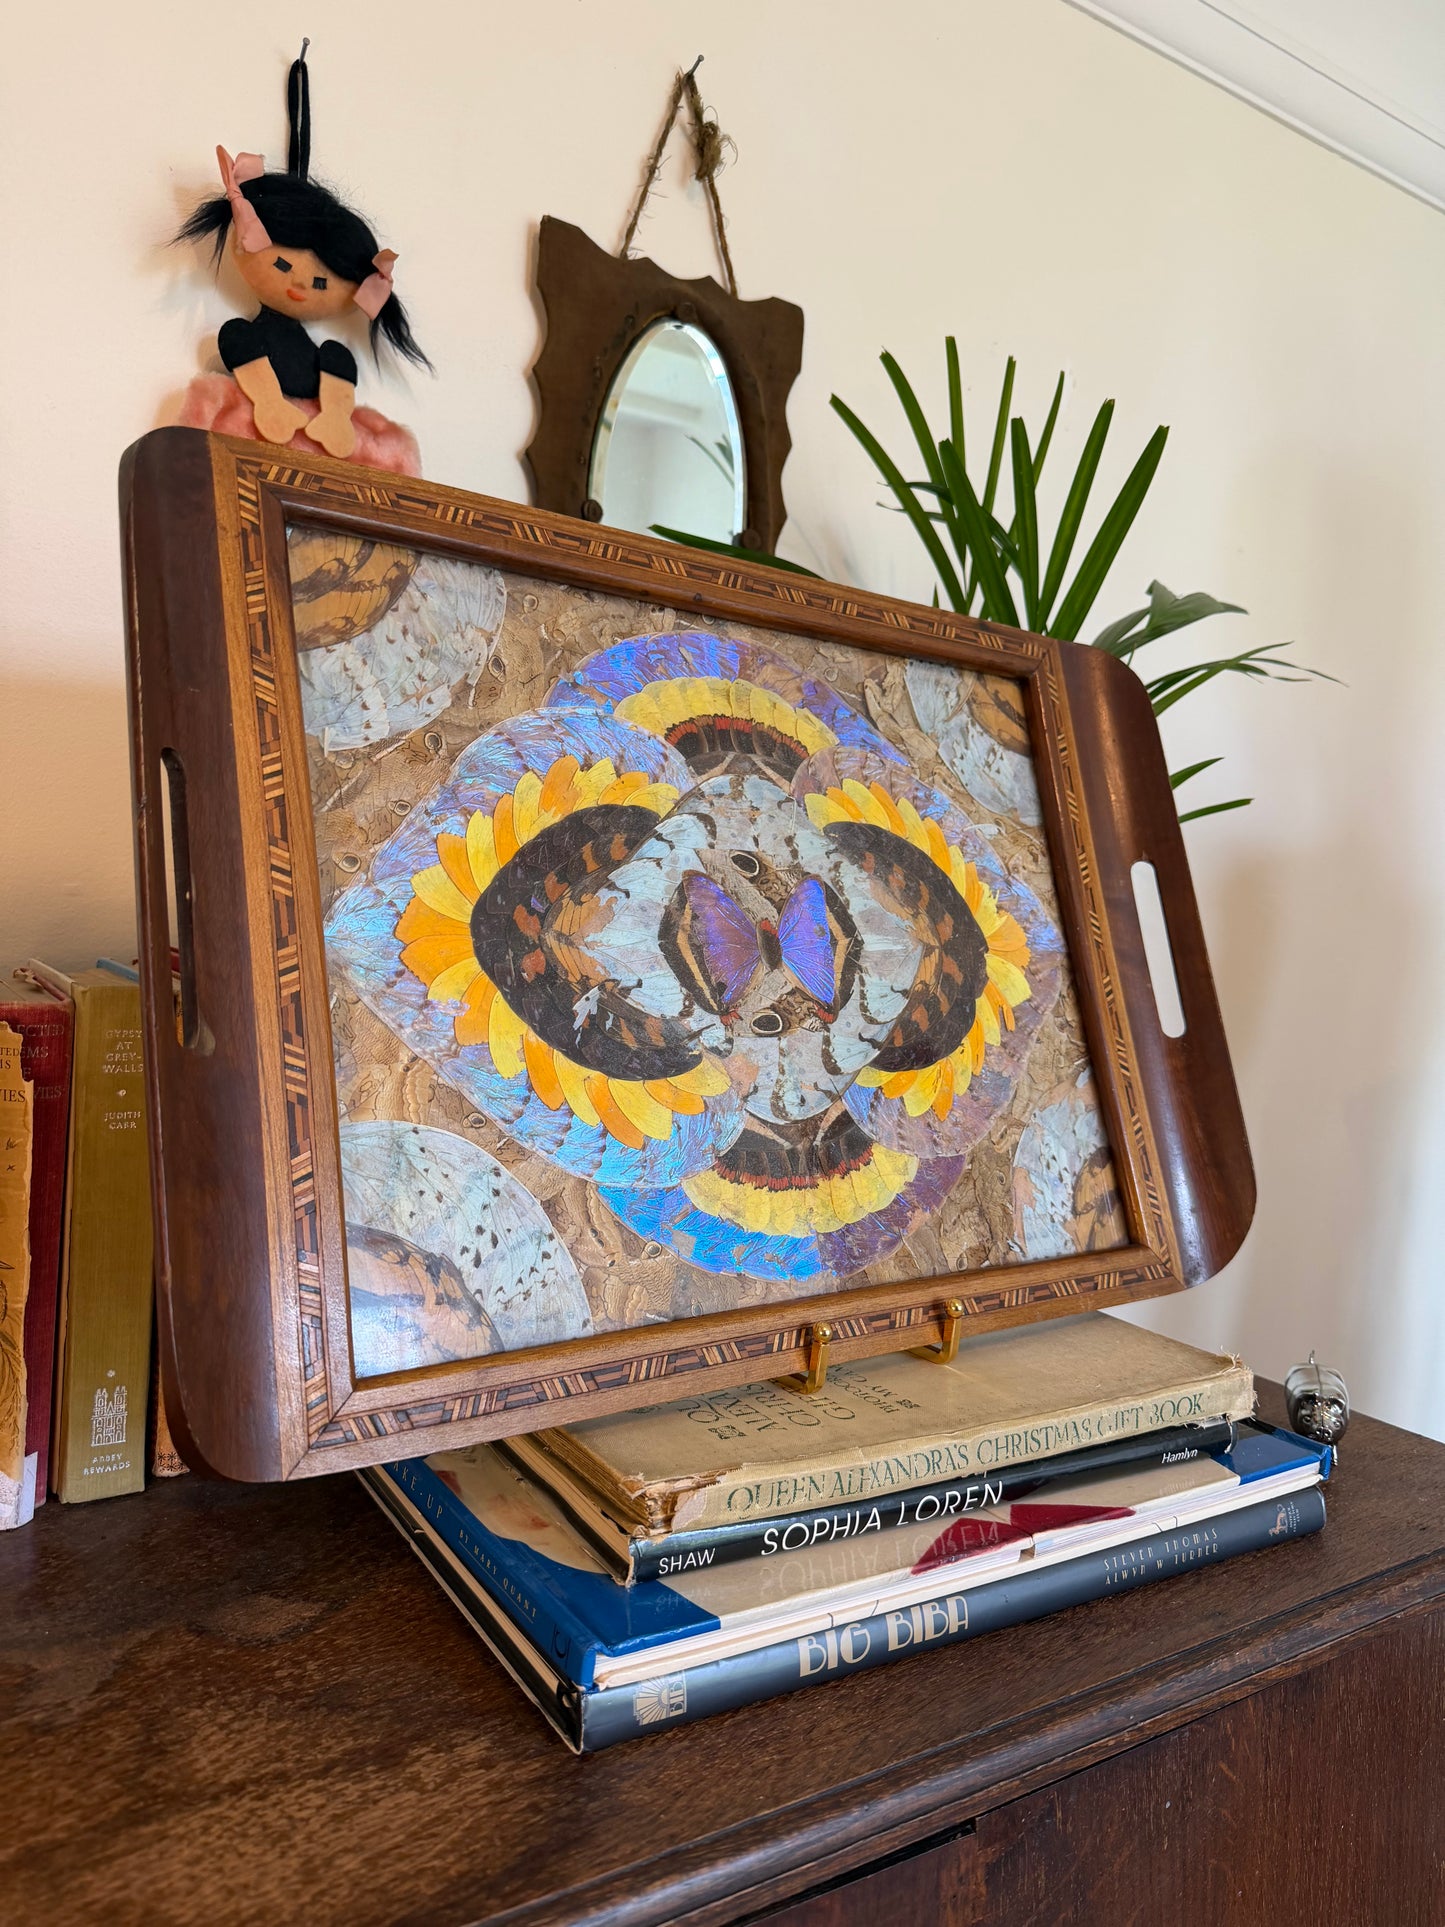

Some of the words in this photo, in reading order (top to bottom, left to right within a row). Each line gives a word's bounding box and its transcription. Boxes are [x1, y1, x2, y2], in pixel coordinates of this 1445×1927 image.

[105, 1029, 143, 1038] GYPSY
[116, 1041, 133, 1050] AT
[106, 1052, 142, 1062] GREY-
[102, 1064, 144, 1073] WALLS
[104, 1111, 142, 1122] JUDITH
[108, 1121, 137, 1130] CARR
[727, 1474, 826, 1521] QUEEN
[828, 1442, 969, 1499] ALEXANDRA'S
[976, 1417, 1093, 1466] CHRISTMAS
[1097, 1406, 1145, 1437] GIFT
[1149, 1393, 1206, 1425] BOOK
[1161, 1448, 1198, 1464] Hamlyn
[83, 1460, 131, 1476] REWARDS
[658, 1548, 716, 1575] SHAW
[761, 1507, 882, 1556] SOPHIA
[896, 1481, 1004, 1527] LOREN
[1103, 1547, 1153, 1571] STEVEN
[1164, 1528, 1219, 1554] THOMAS
[1105, 1563, 1146, 1586] ALWYN
[1156, 1559, 1164, 1570] W
[1174, 1543, 1219, 1566] TURNER
[458, 1529, 470, 1544] BY
[473, 1546, 499, 1576] MARY
[503, 1578, 538, 1618] QUANT
[797, 1622, 871, 1678] BIG
[885, 1596, 969, 1652] BIBA
